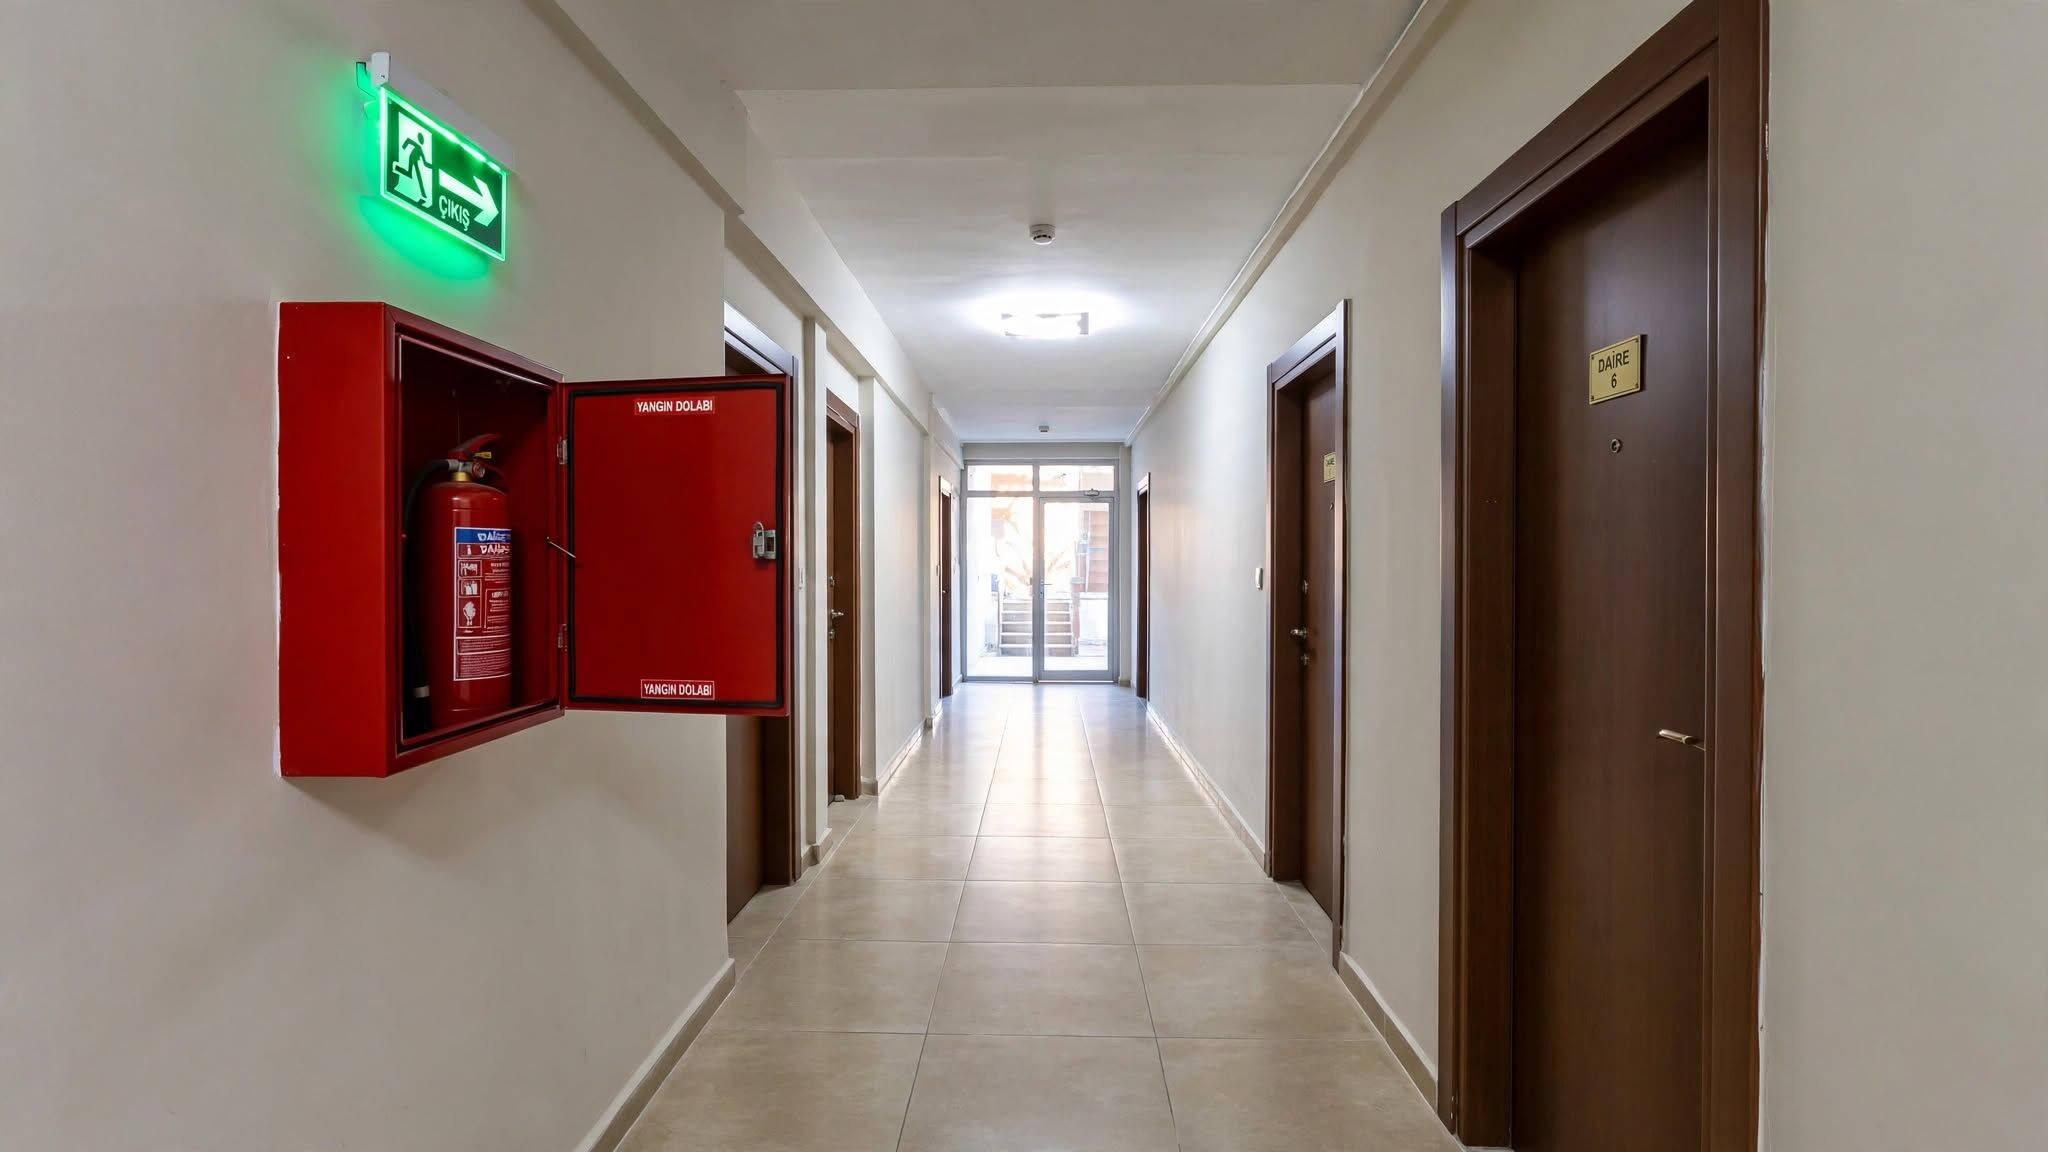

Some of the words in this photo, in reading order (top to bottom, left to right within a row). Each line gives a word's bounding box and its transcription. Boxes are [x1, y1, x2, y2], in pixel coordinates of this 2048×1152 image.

[438, 194, 470, 232] ÇIKIŞ
[1598, 349, 1630, 373] DAİRE
[1611, 372, 1618, 389] 6
[637, 400, 673, 413] YANGIN
[675, 399, 713, 412] DOLABI
[643, 683, 677, 696] YANGIN
[678, 683, 712, 696] DOLABI
